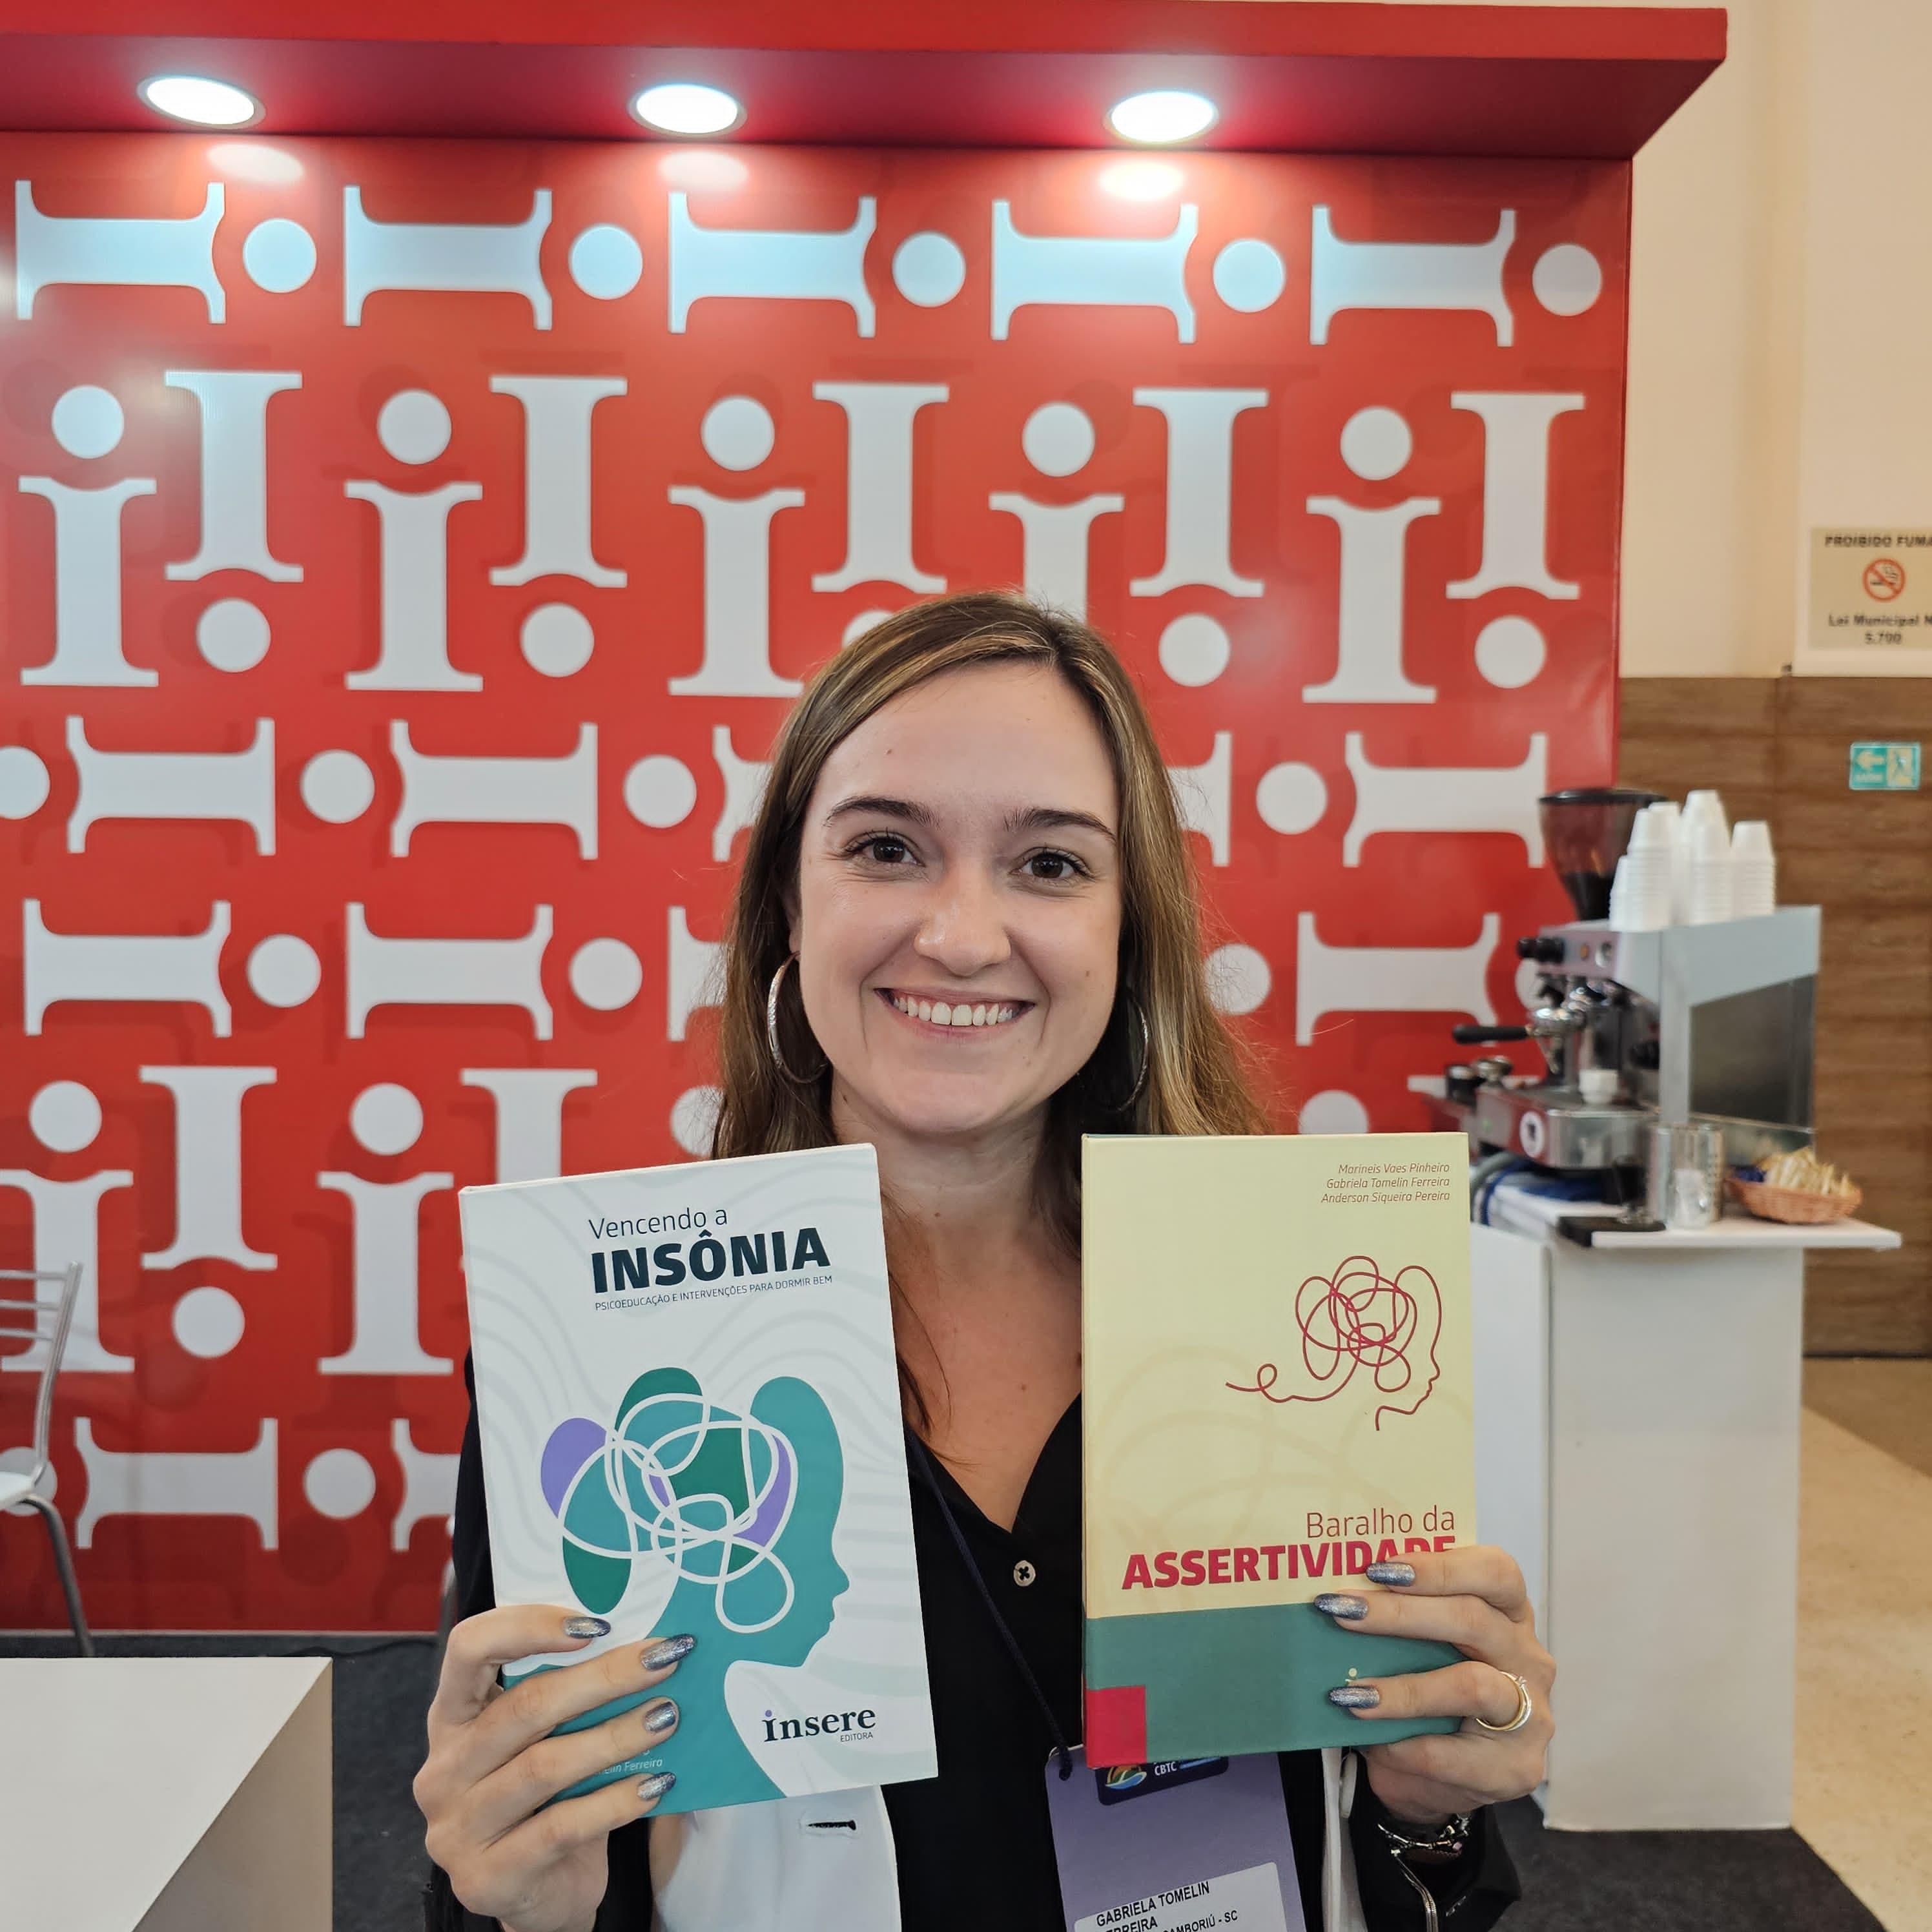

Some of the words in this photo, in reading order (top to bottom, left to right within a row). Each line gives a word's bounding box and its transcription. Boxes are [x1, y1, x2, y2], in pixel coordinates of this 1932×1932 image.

[1825, 536, 1892, 548] PROIBIDO
[1829, 614, 1849, 626] Lei
[1853, 614, 1918, 628] Municipal
[1339, 1164, 1381, 1174] Marineis
[1384, 1163, 1406, 1173] Vaes
[1410, 1162, 1450, 1173] Pinheiro
[1327, 1178, 1368, 1189] Gabriela
[1371, 1177, 1408, 1187] Tomelin
[1411, 1177, 1450, 1187] Ferreira
[1321, 1193, 1369, 1202] Anderson
[1372, 1191, 1412, 1204] Siqueira
[1415, 1191, 1450, 1201] Pereira
[589, 1207, 706, 1240] Vencendo
[715, 1209, 728, 1226] a
[591, 1228, 831, 1293] INSÔNIA
[595, 1293, 670, 1311] PSICOEDUCAÇÃO
[673, 1293, 678, 1302] E
[680, 1284, 748, 1302] INTERVENÇÕES
[750, 1282, 774, 1292] PARA
[776, 1277, 811, 1290] DORMIR
[814, 1275, 832, 1285] BEM
[1307, 1508, 1413, 1538] Baralho
[1423, 1505, 1455, 1532] da
[762, 1709, 876, 1742] insere
[841, 1732, 874, 1742] EDITORA
[1154, 1762, 1177, 1776] CBTC
[1096, 1898, 1156, 1926] GABRIELA
[1158, 1881, 1209, 1907] TOMELIN
[1224, 1909, 1238, 1923] SC
